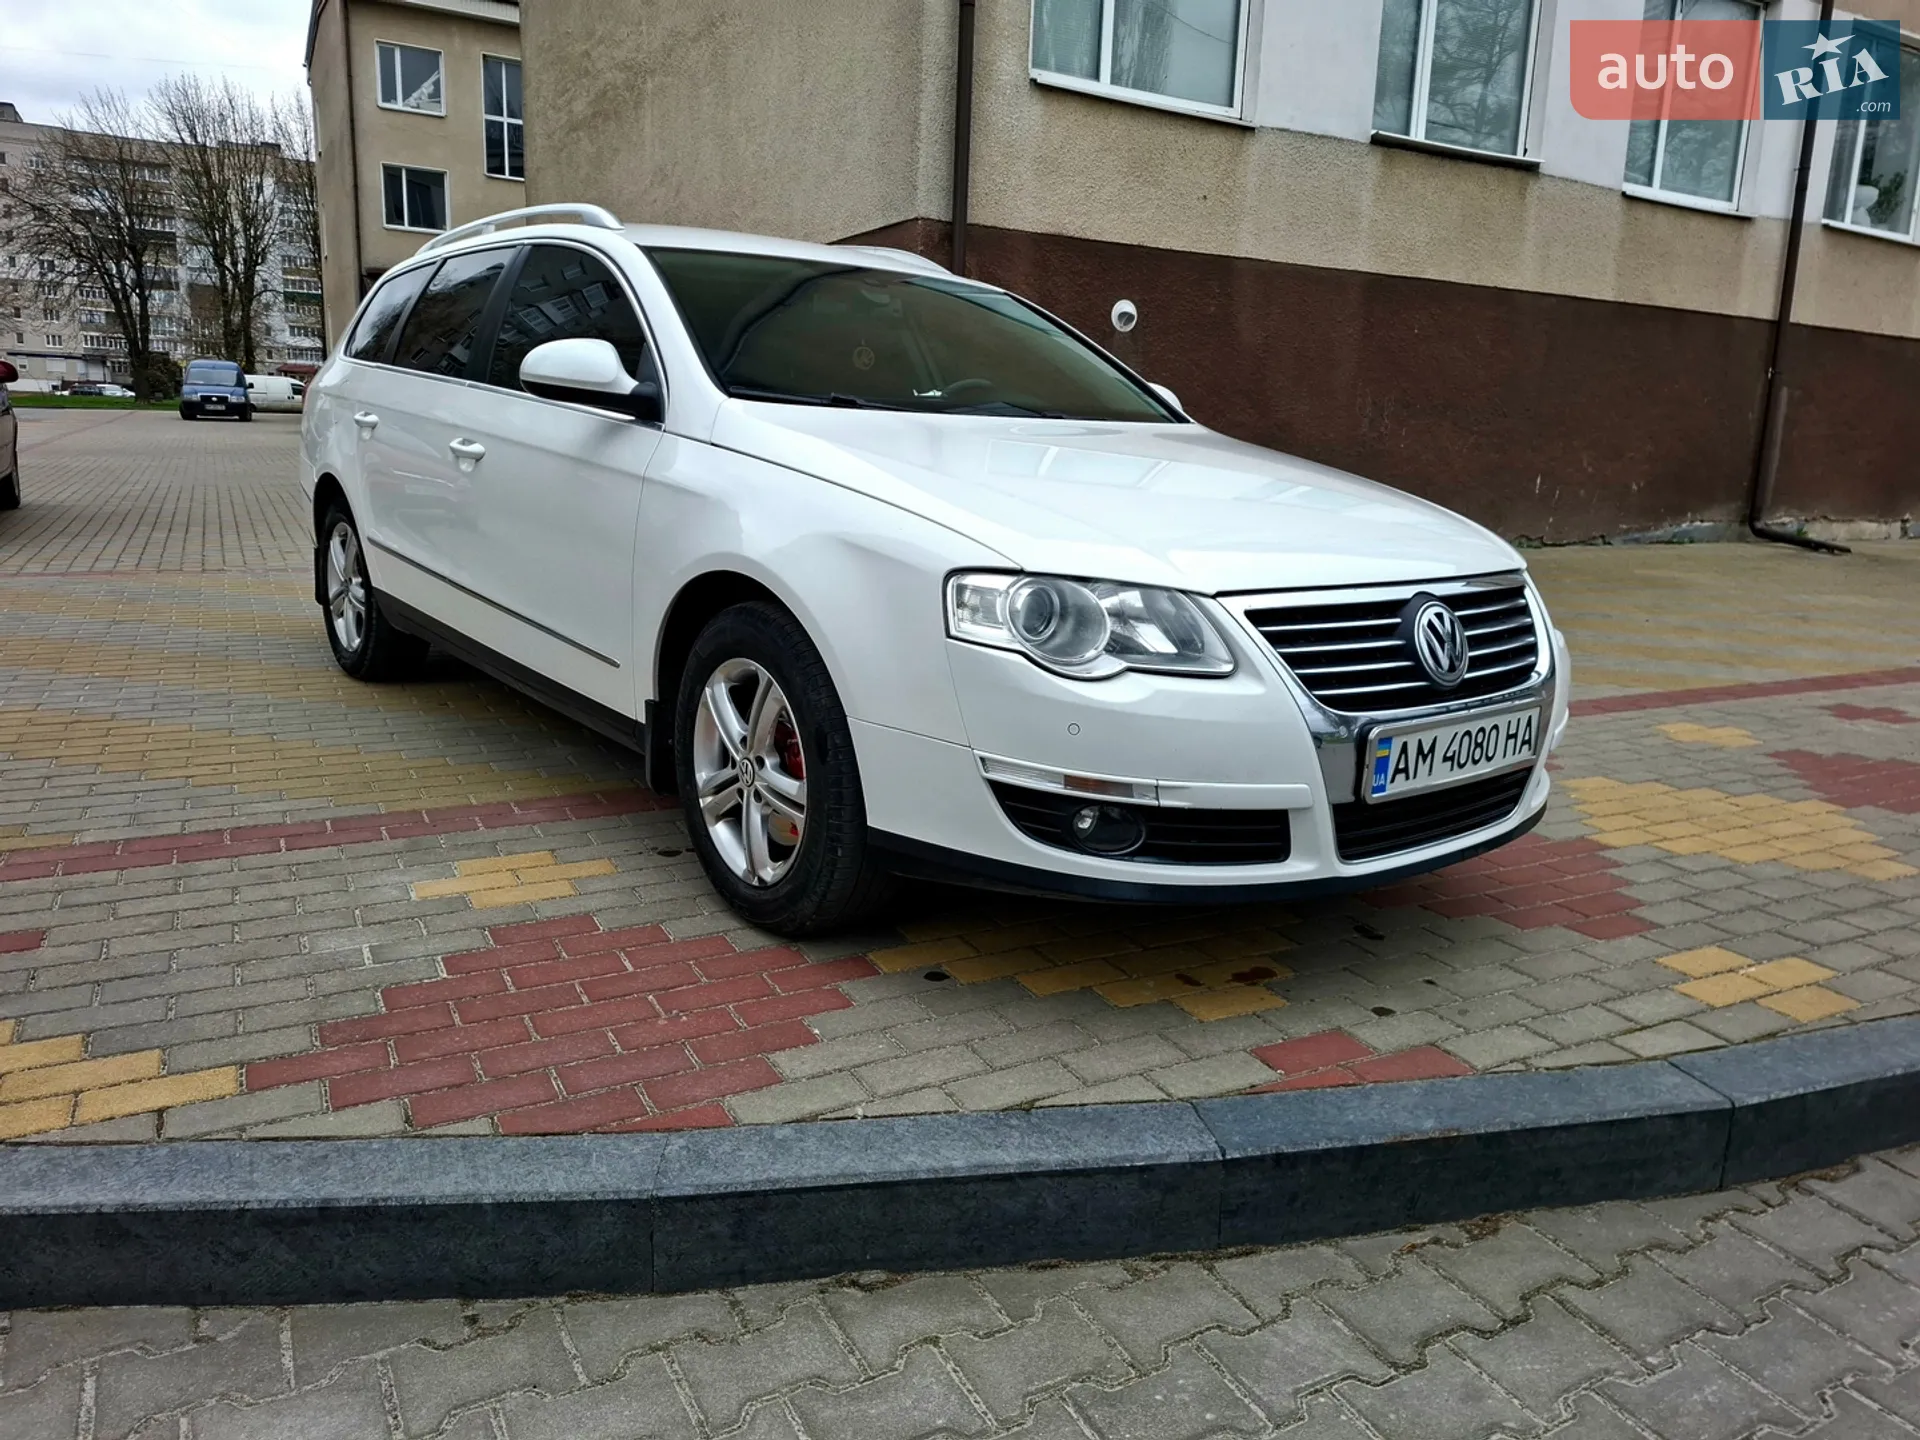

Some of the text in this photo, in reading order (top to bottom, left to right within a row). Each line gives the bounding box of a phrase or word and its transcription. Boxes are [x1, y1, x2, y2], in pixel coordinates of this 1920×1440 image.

[1418, 603, 1466, 682] VW
[1372, 773, 1385, 786] UA
[1390, 715, 1532, 784] AM 4080 HA
